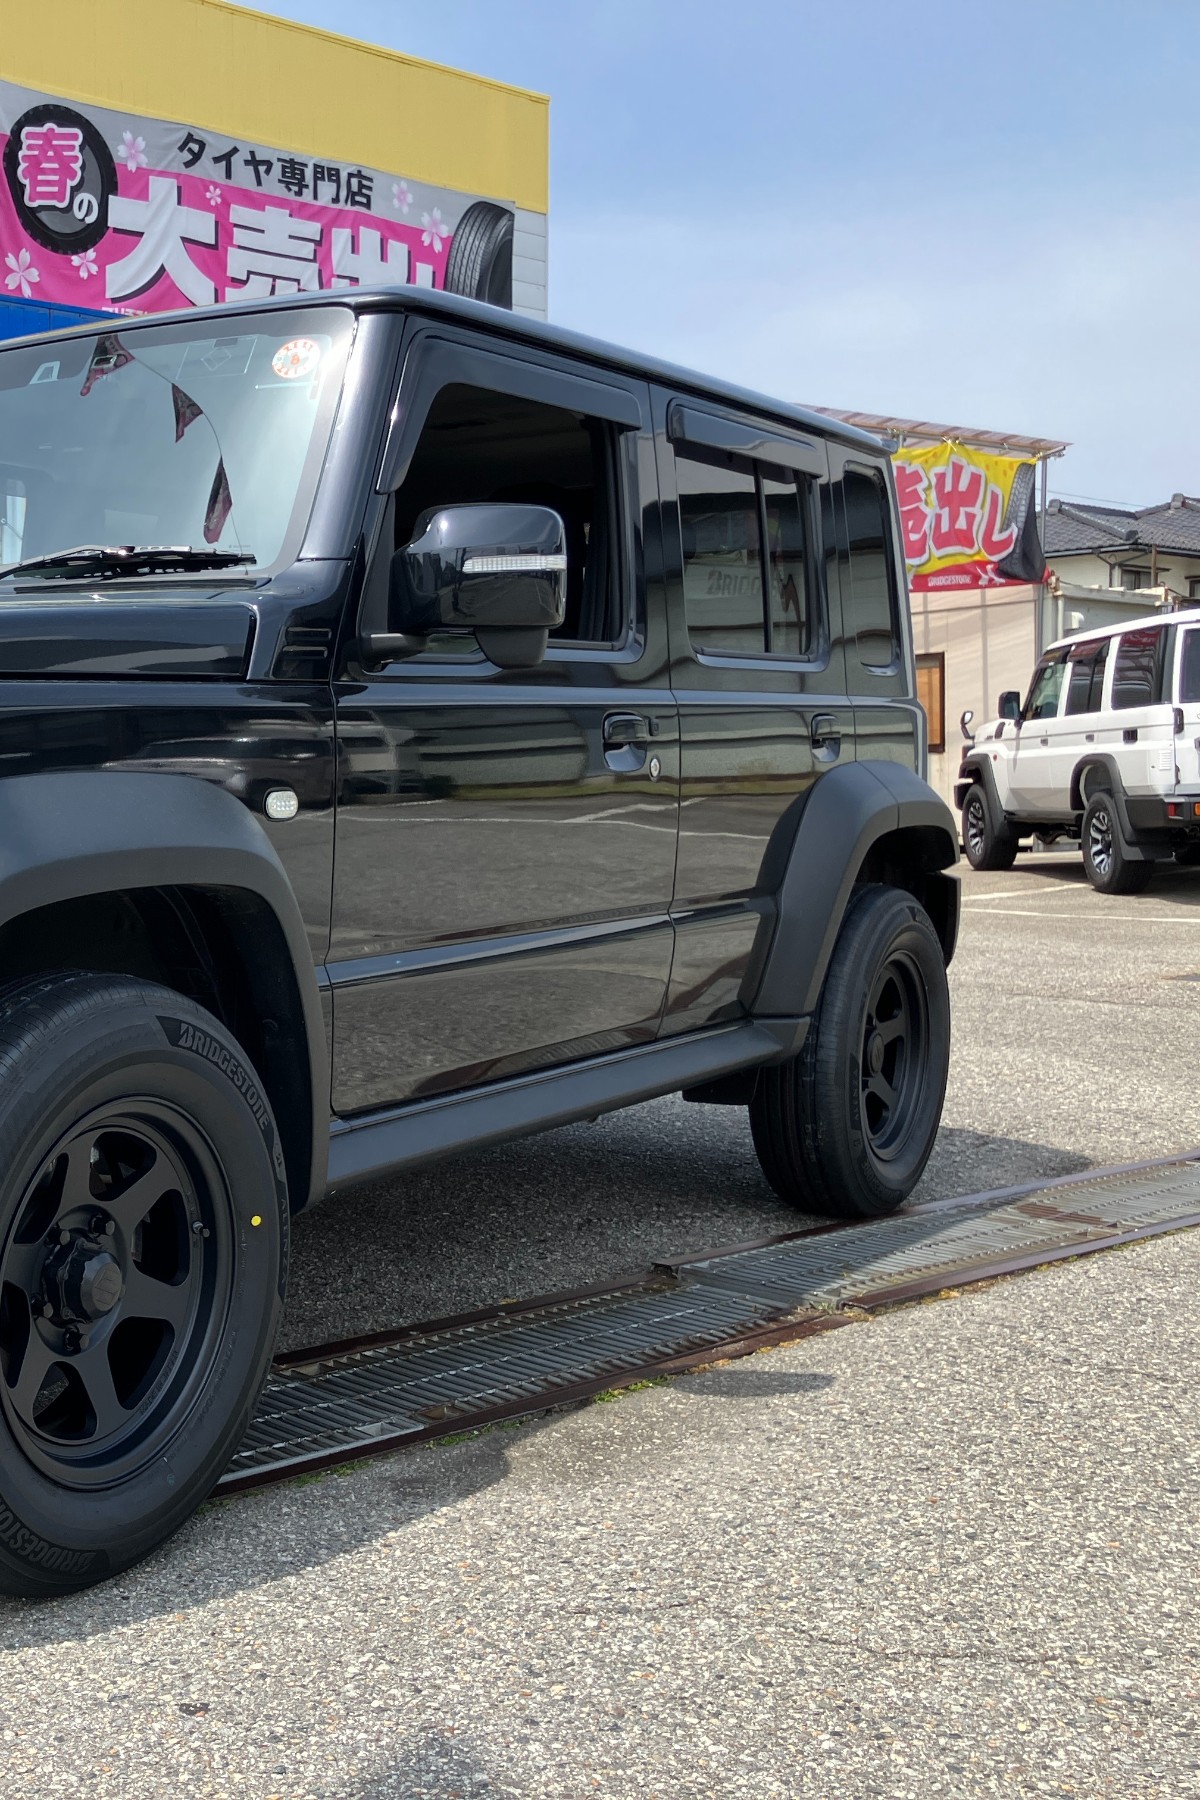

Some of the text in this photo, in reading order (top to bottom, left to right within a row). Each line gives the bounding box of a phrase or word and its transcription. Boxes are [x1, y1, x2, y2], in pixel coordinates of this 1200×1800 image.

[18, 122, 99, 225] 春の
[176, 131, 374, 211] タイヤ専門店
[927, 575, 972, 587] BRIDGESTONE
[178, 1022, 270, 1130] BRIDGESTONE
